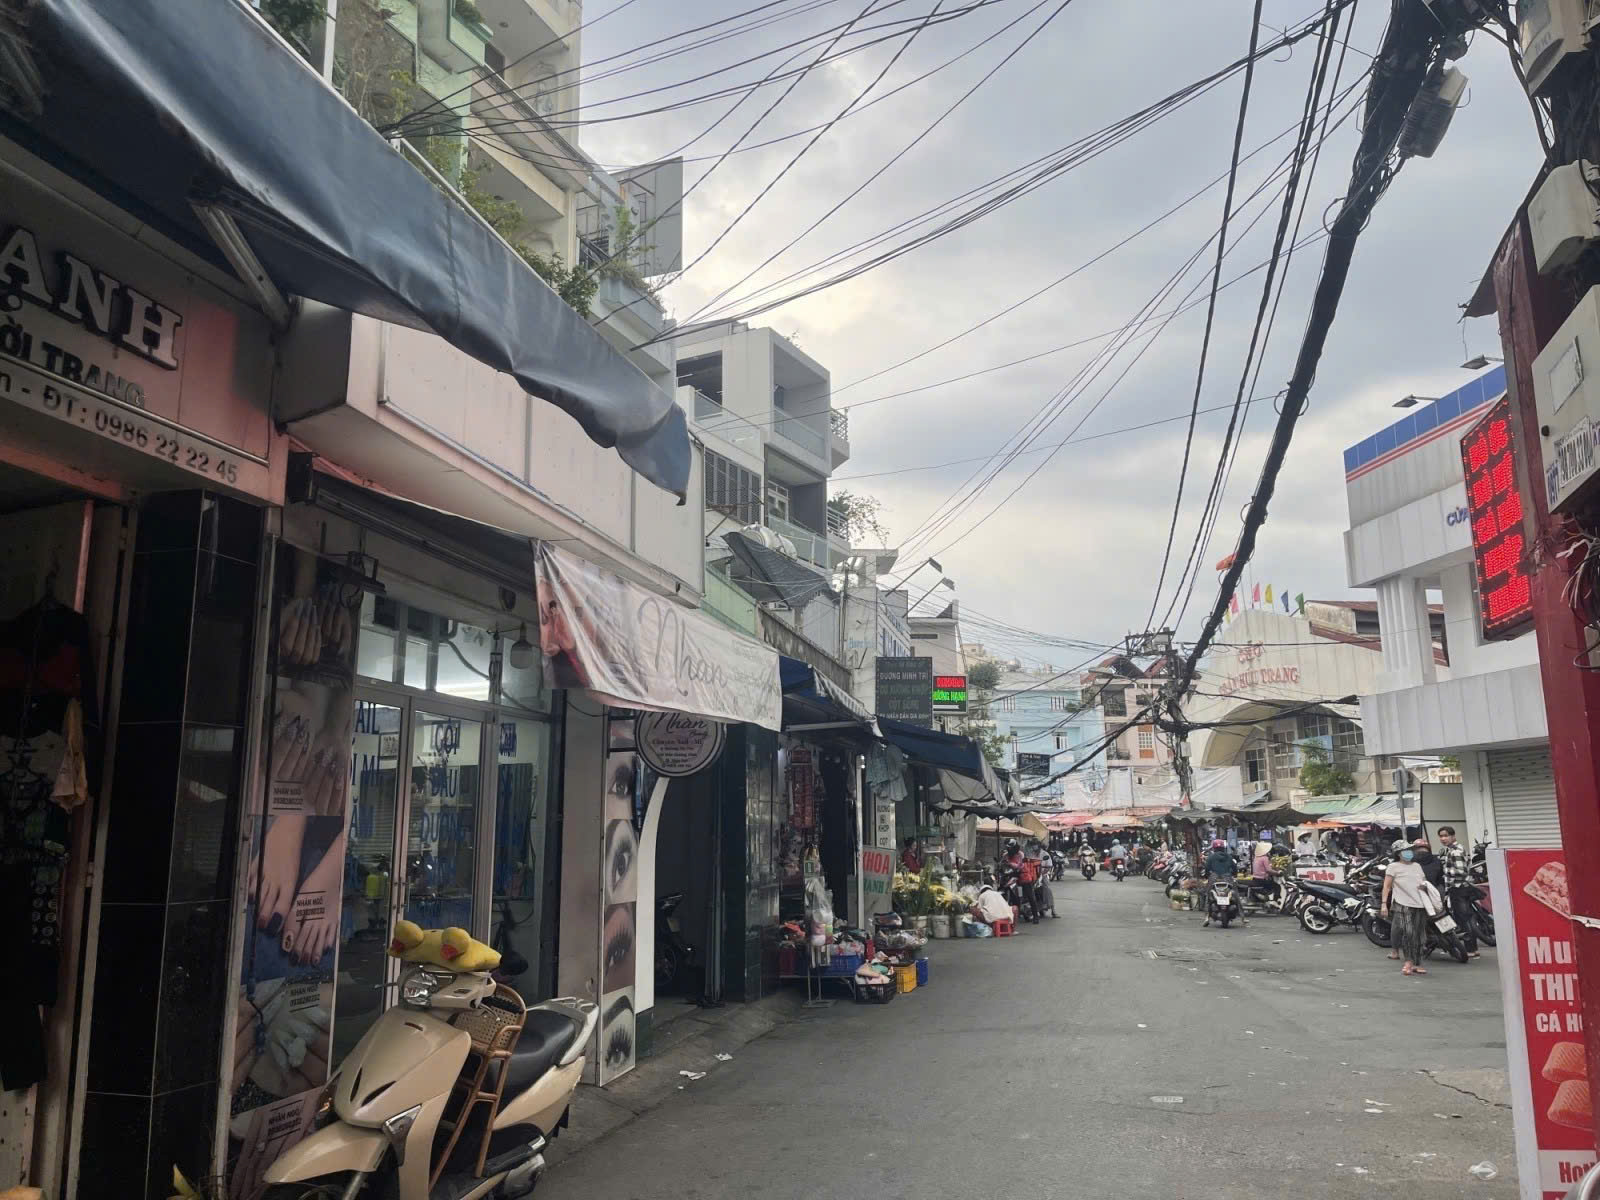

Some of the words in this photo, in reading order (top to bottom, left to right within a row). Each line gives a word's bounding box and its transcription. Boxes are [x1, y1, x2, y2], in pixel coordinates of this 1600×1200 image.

[42, 341, 144, 411] TRANG
[95, 409, 148, 448] 0986
[154, 434, 180, 463] 22
[185, 446, 209, 473] 22
[215, 459, 238, 484] 45
[1260, 666, 1299, 685] TRANG
[1527, 936, 1577, 965] Mu
[1535, 1009, 1562, 1033] CÁ
